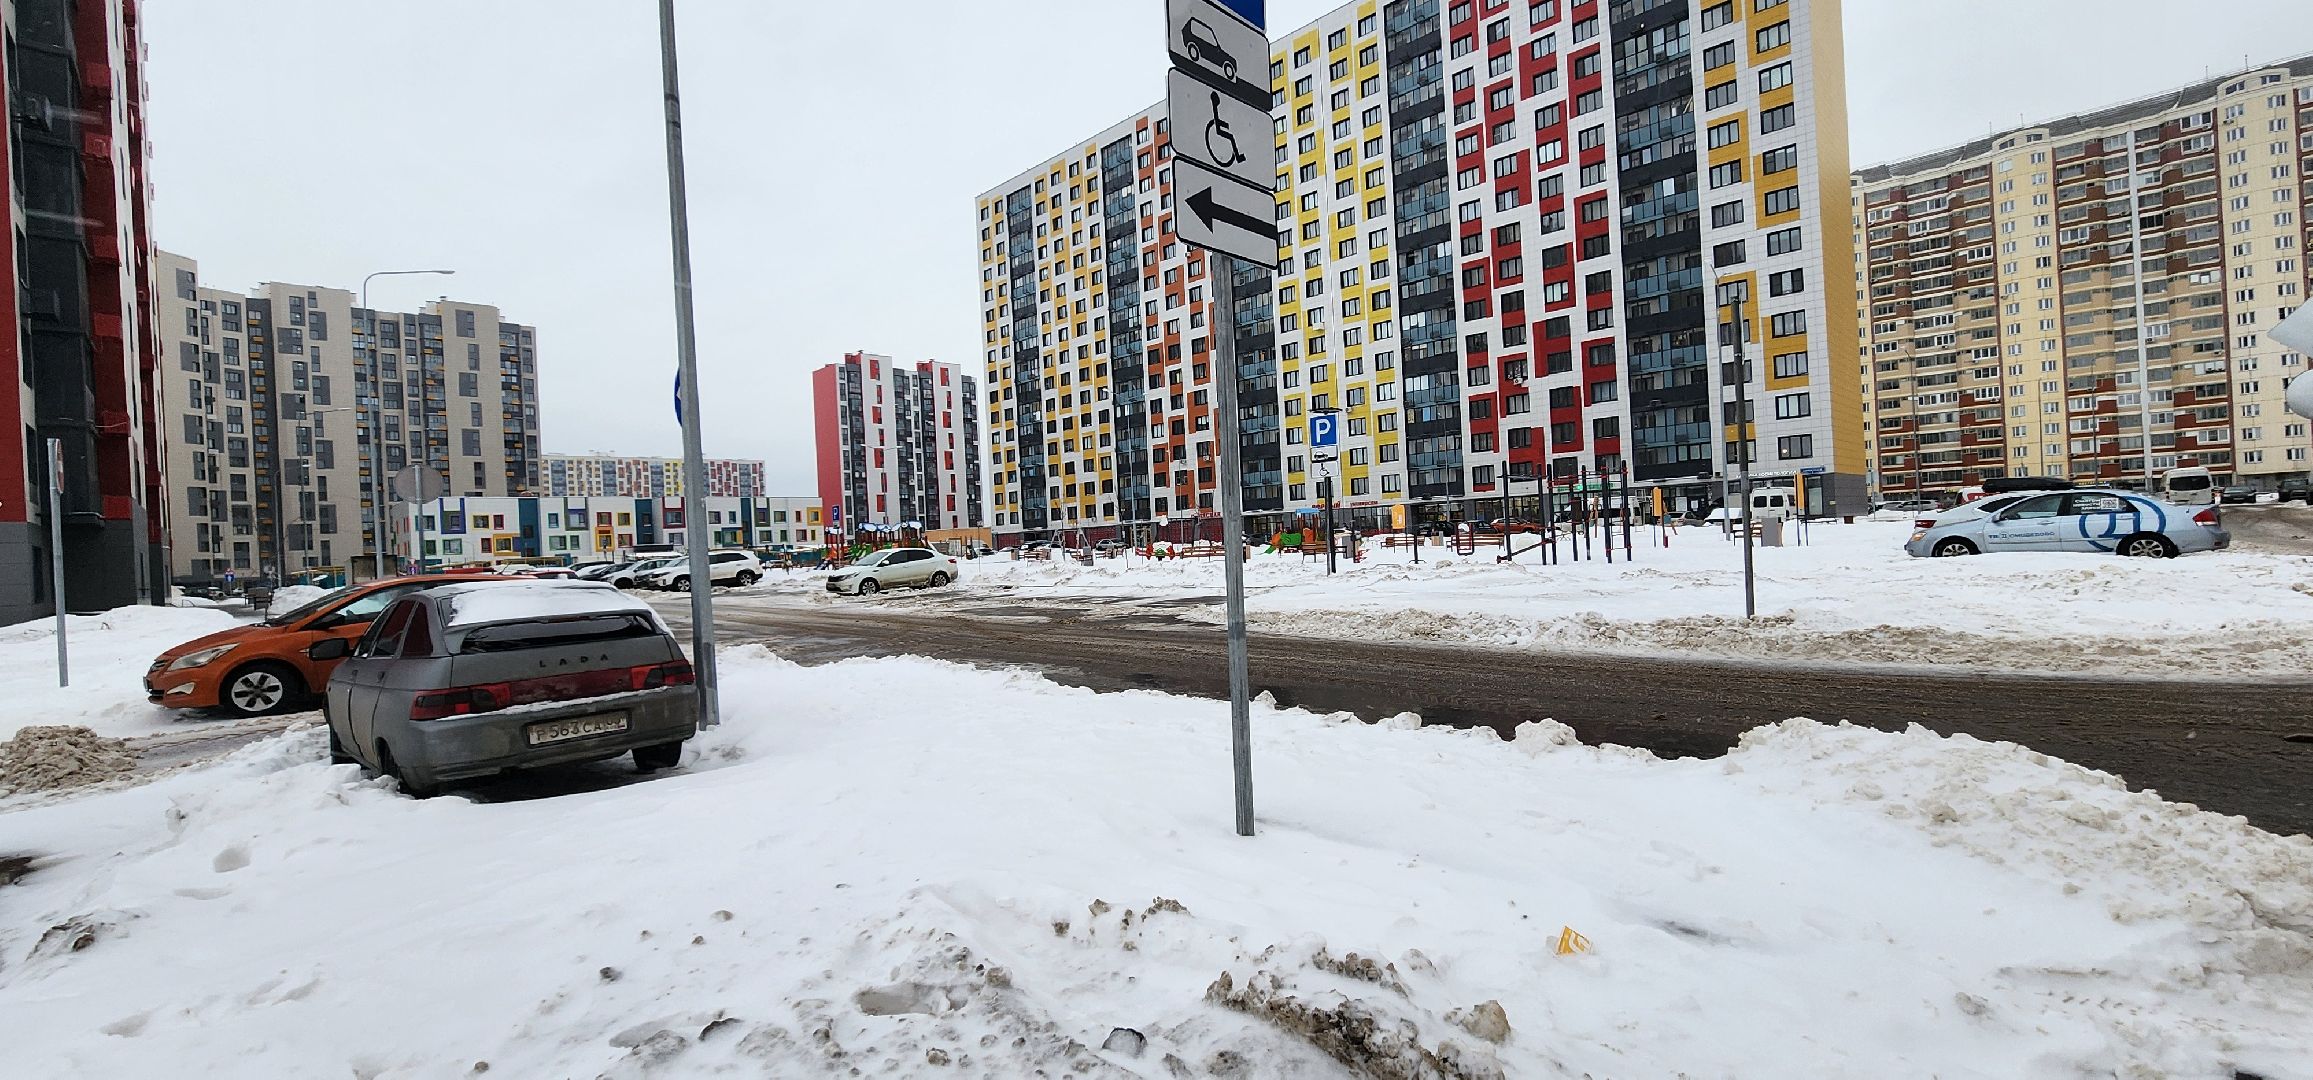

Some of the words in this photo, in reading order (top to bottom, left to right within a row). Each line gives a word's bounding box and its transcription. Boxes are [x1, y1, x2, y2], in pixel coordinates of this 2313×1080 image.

[1315, 418, 1331, 443] P
[833, 507, 839, 520] P
[539, 653, 609, 668] LADA
